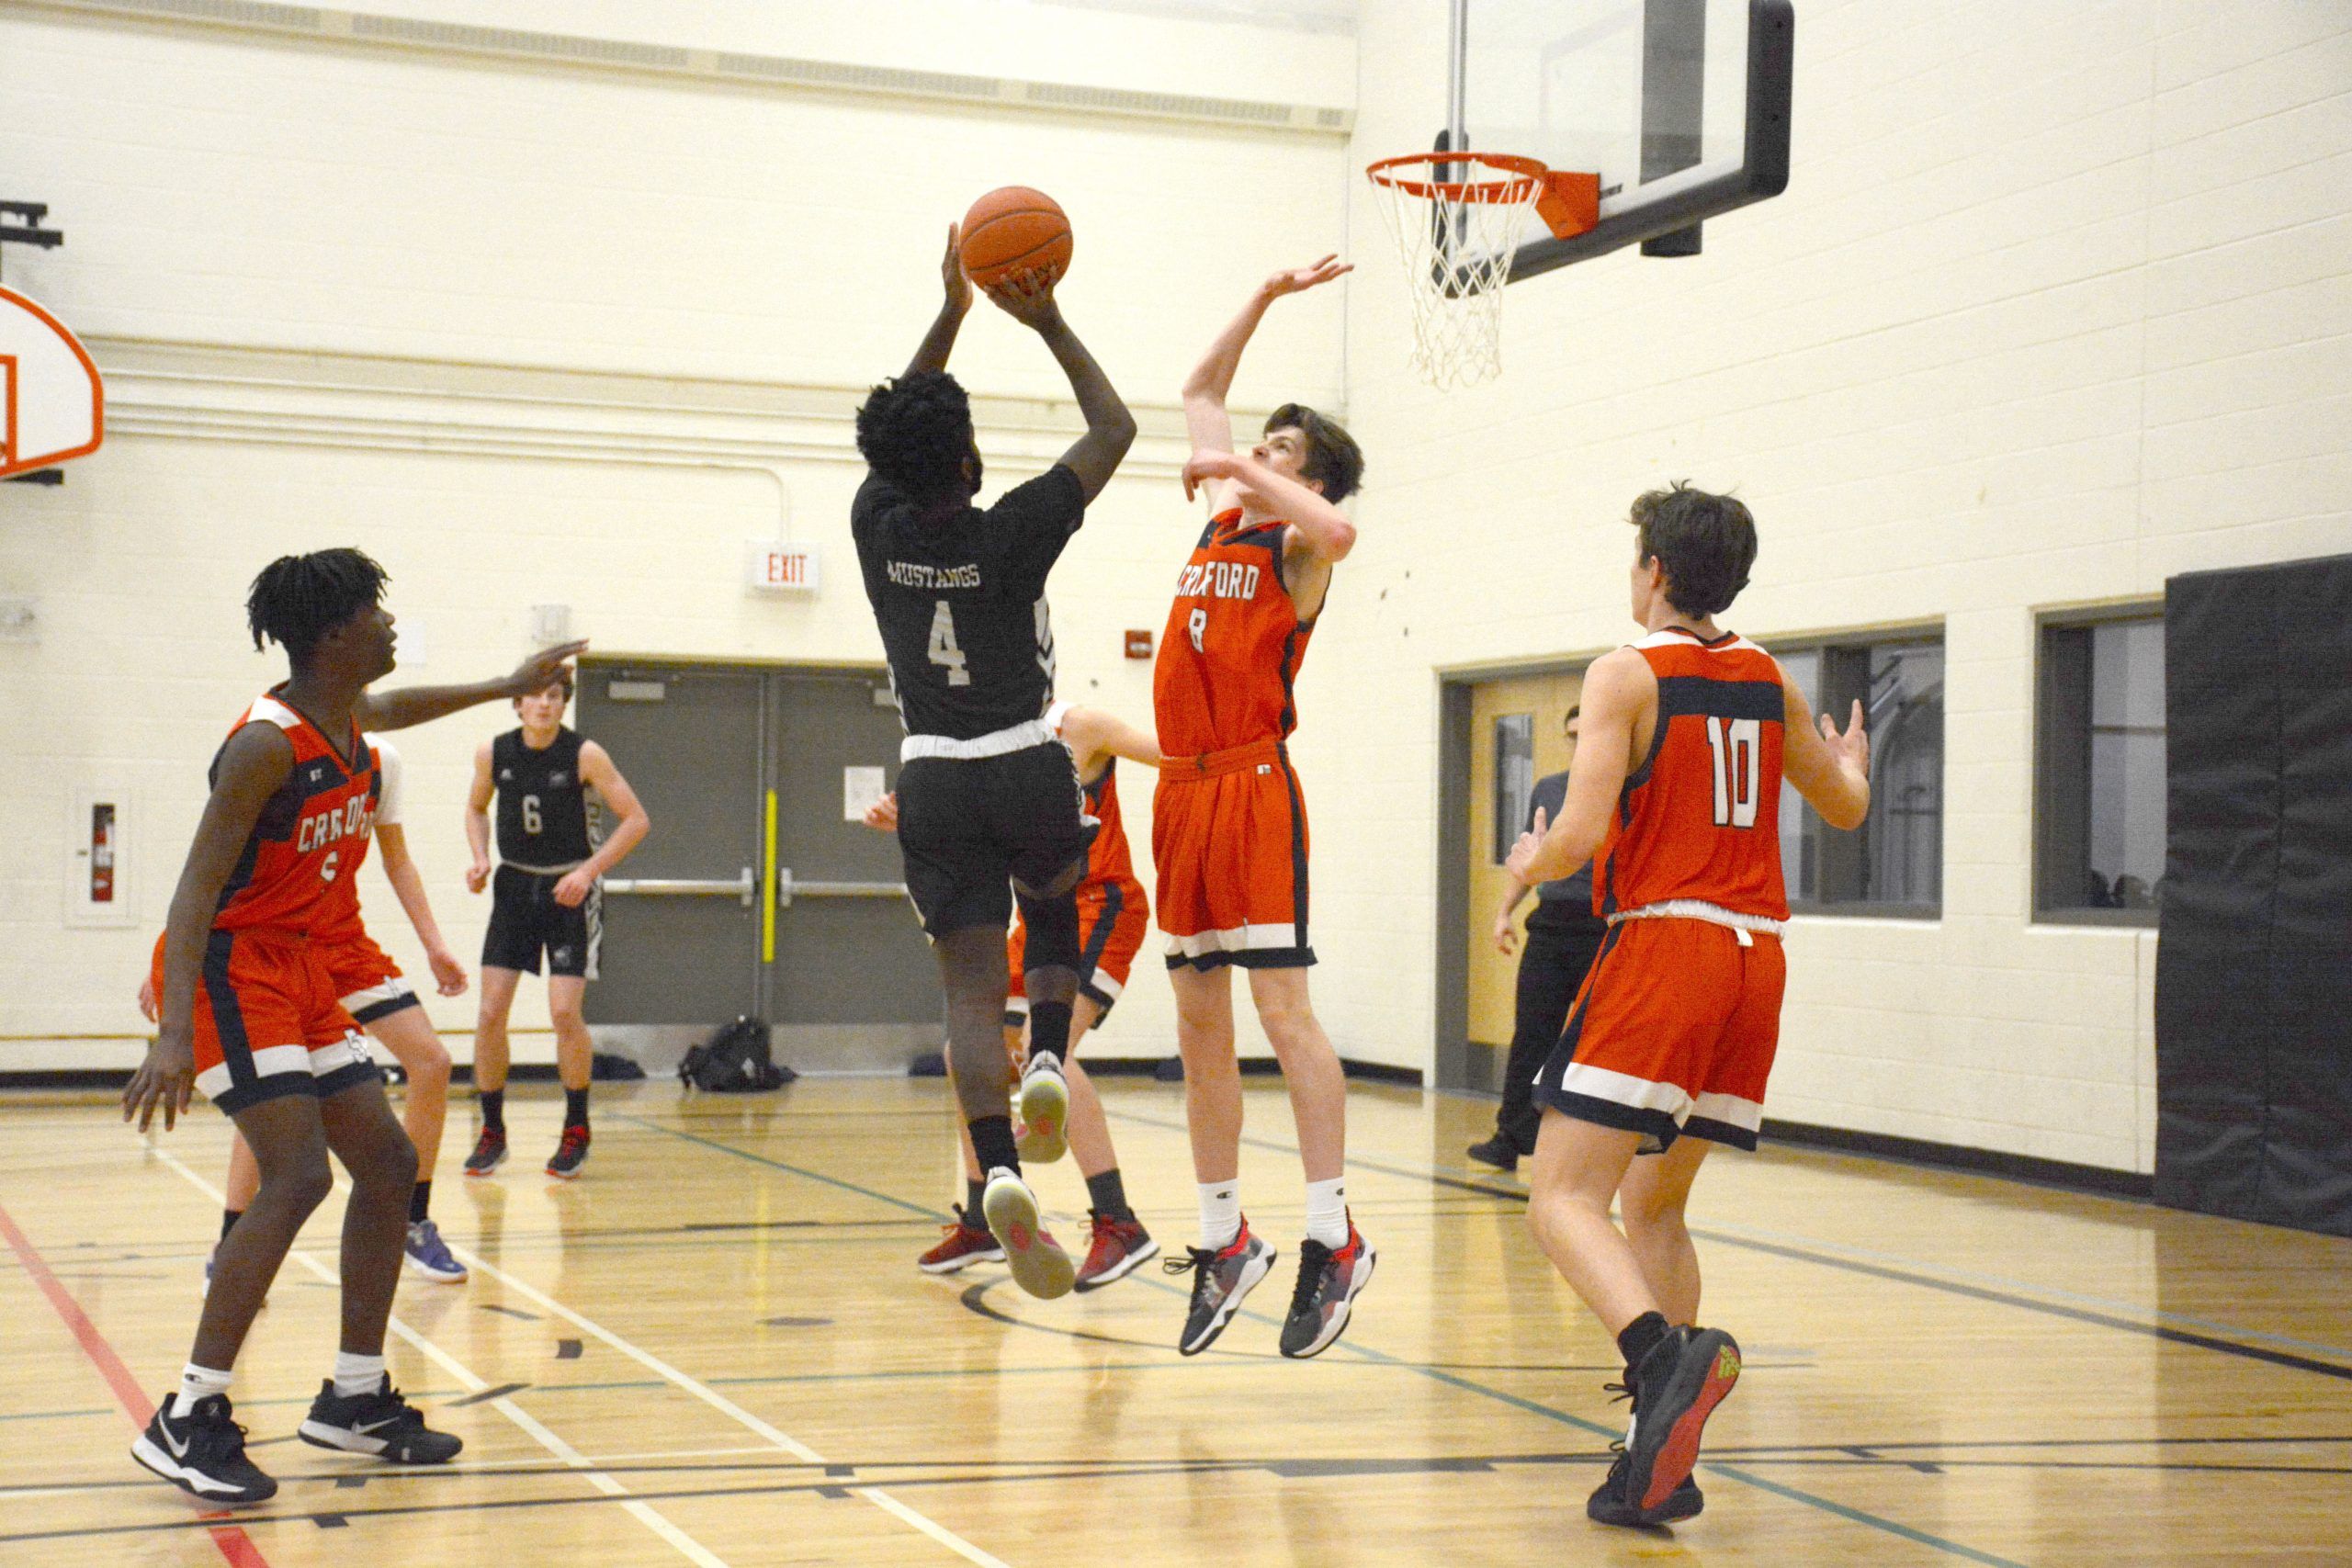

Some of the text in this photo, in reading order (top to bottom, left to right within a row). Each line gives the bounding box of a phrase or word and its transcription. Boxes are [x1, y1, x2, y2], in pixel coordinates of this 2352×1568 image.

[768, 553, 807, 583] EXIT
[888, 559, 980, 588] MUSTANGS
[928, 600, 970, 686] 4
[1707, 716, 1760, 828] 10
[523, 794, 543, 834] 6
